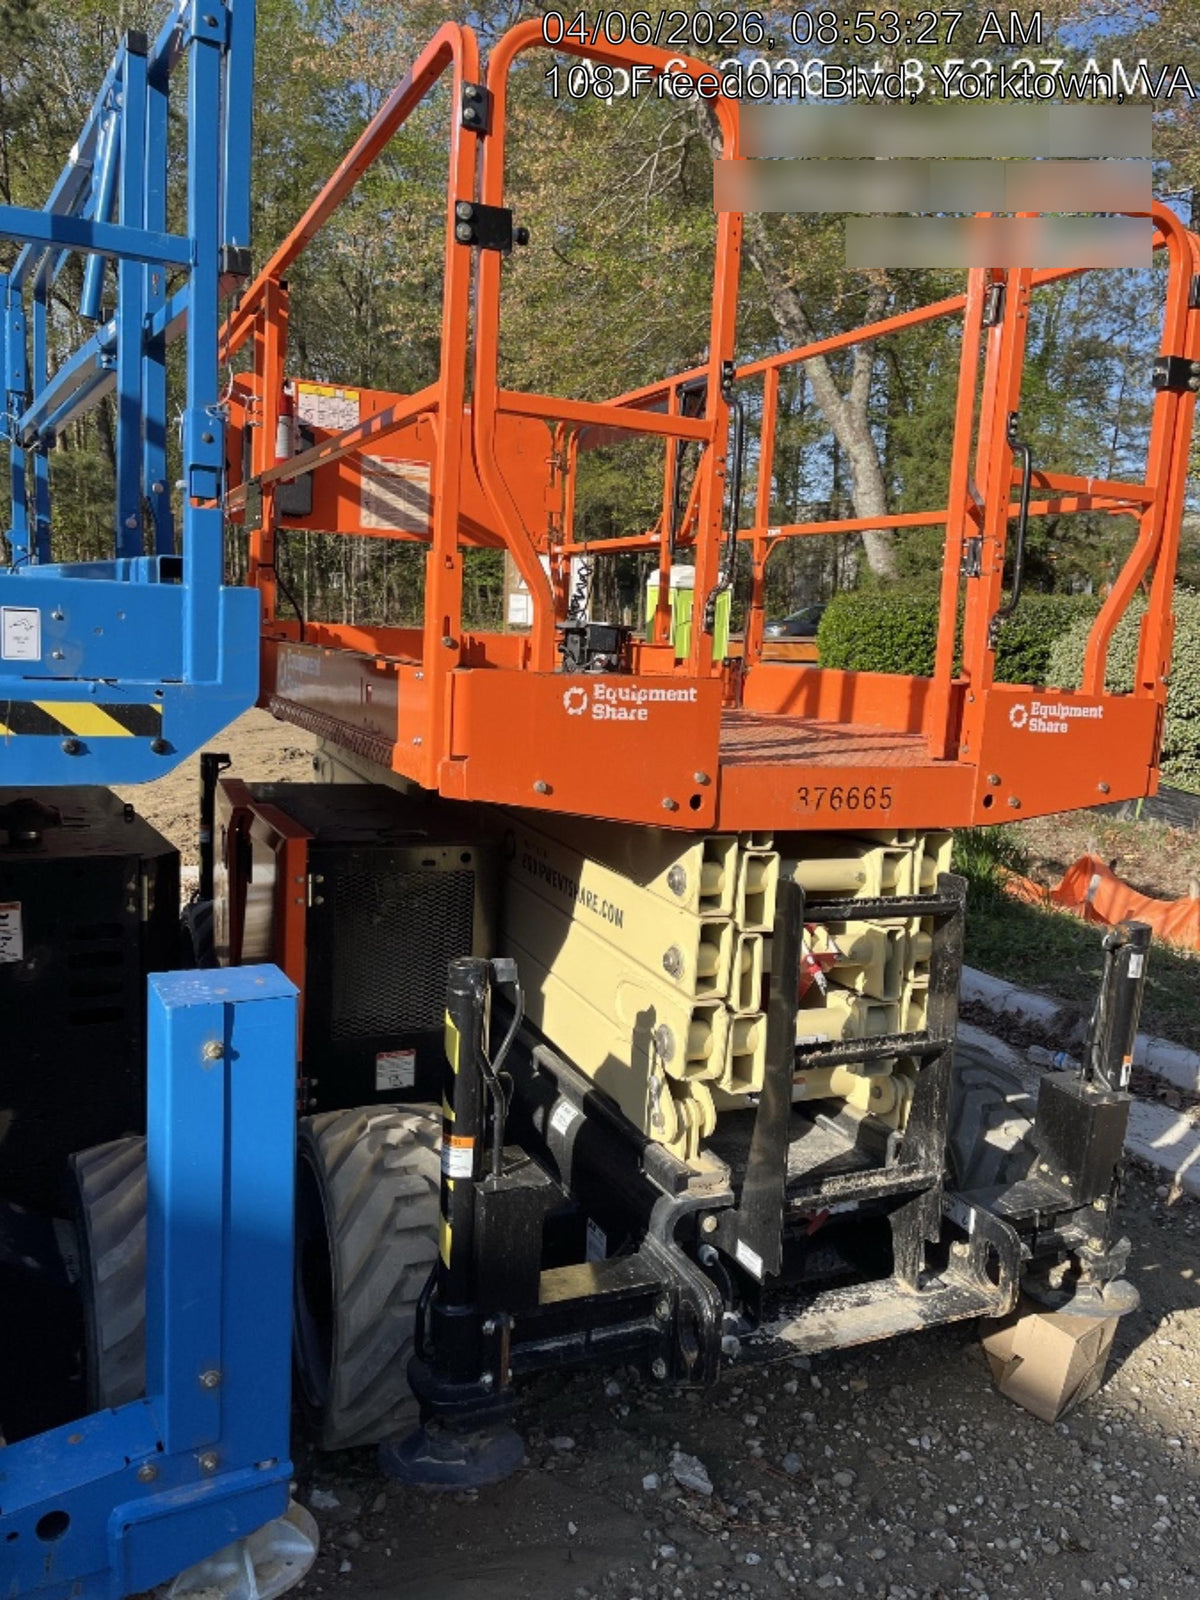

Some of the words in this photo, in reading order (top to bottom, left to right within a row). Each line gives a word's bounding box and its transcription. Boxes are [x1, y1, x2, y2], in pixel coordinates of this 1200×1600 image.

[593, 683, 698, 705] Equipment
[591, 703, 648, 721] Share
[1030, 701, 1104, 720] Equipment
[1028, 718, 1068, 733] Share
[797, 786, 892, 811] 376665
